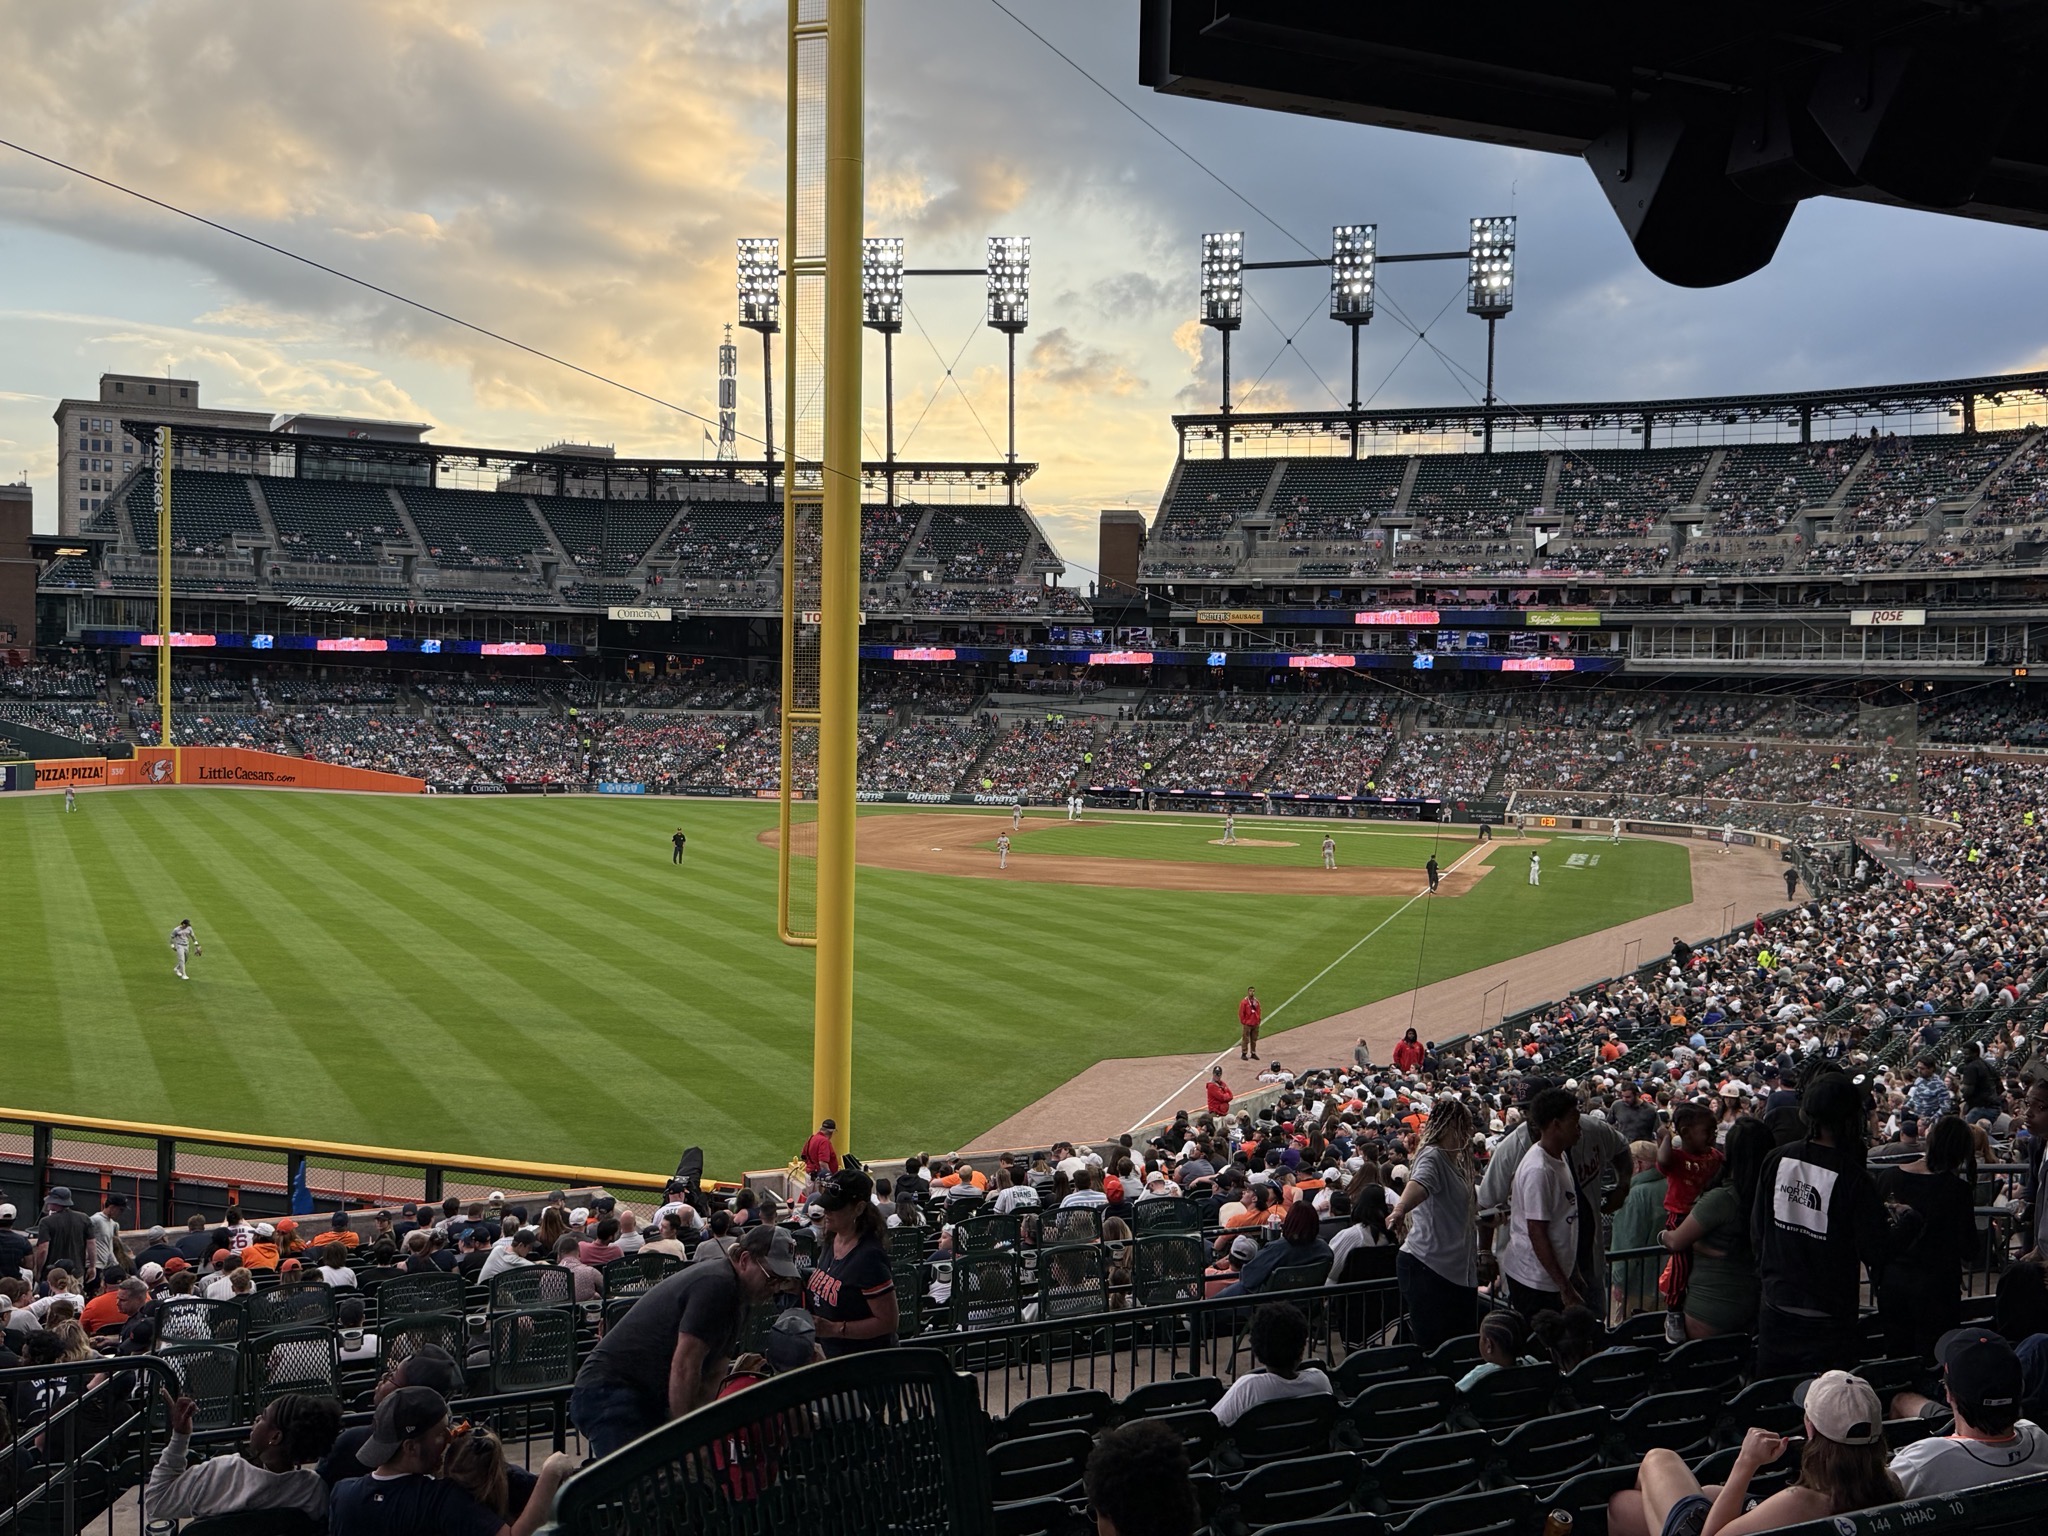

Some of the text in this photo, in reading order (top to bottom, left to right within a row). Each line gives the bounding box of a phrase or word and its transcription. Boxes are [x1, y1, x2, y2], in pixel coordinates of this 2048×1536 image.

[154, 445, 165, 514] Rocket
[372, 602, 406, 613] TIGER
[417, 603, 445, 614] CLUB
[1871, 611, 1904, 624] ROSE
[35, 766, 104, 781] PIZZA! PIZZA!
[907, 792, 951, 801] Dunham's
[974, 794, 1018, 803] Dunham's
[1780, 1184, 1811, 1200] NORTH
[1796, 1180, 1812, 1193] THE
[1012, 1190, 1031, 1199] EVANS
[1788, 1192, 1809, 1206] FACE
[1868, 1501, 1964, 1533] 144 HHAC 10
